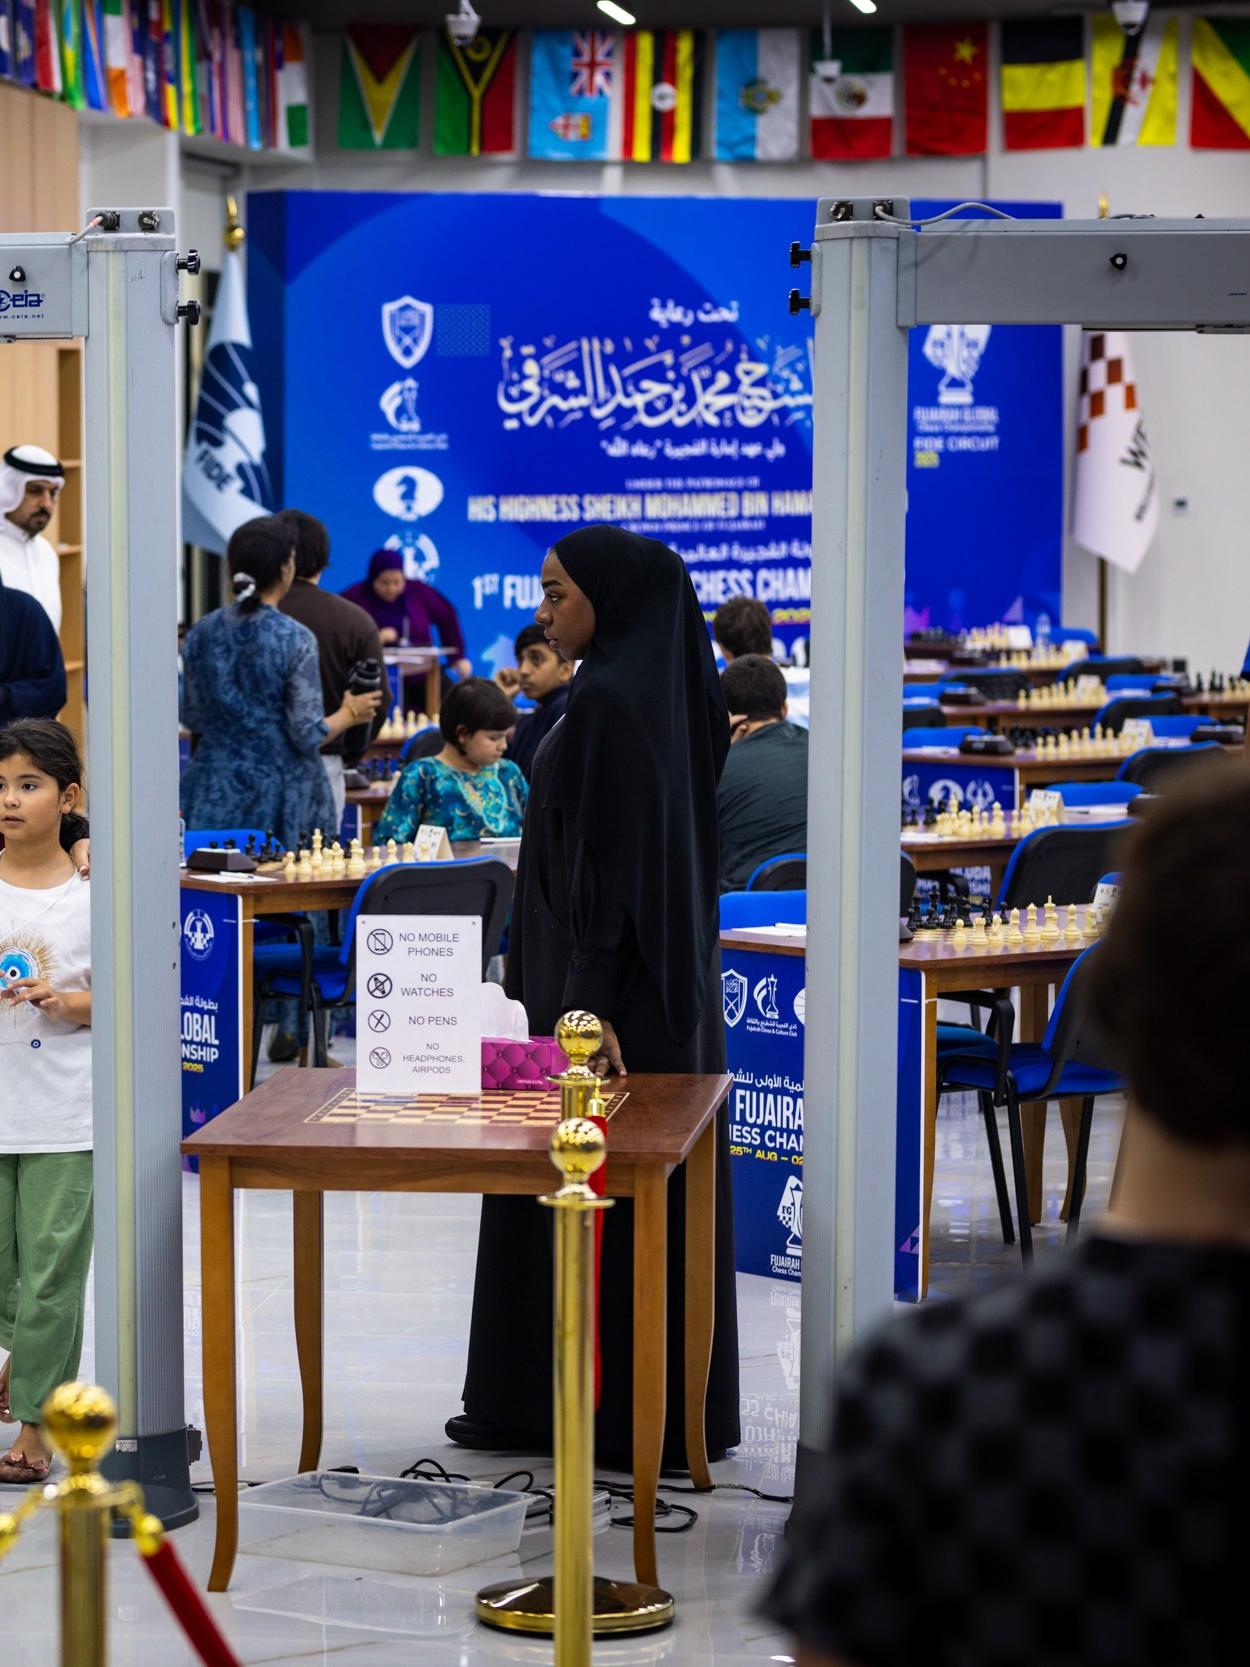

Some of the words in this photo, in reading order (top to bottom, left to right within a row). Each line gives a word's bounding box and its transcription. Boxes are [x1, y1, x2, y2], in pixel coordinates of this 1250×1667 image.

[650, 298, 695, 328] رعاية
[697, 300, 739, 322] تحت
[468, 495, 497, 522] HIS
[499, 494, 580, 521] HIGHNESS
[582, 492, 642, 520] SHEIKH
[644, 491, 740, 518] MOHAMMED
[742, 490, 769, 517] BIN
[691, 569, 754, 604] CHESS
[399, 933, 415, 943] NO
[418, 933, 459, 943] MOBILE
[407, 947, 454, 957] PHONES
[421, 973, 437, 983] NO
[400, 987, 454, 997] WATCHES
[195, 995, 219, 1013] بطولة
[408, 1016, 425, 1026] NO
[428, 1016, 457, 1026] PENS
[181, 1011, 219, 1045] OBAL
[746, 1025, 761, 1033] Fujairah
[761, 1026, 771, 1034] Chess
[776, 1028, 788, 1036] Culture
[426, 1042, 439, 1051] NO
[402, 1055, 465, 1064] HEADPHONES,
[182, 1061, 204, 1073] 2025
[412, 1066, 451, 1074] AIRPODS
[755, 1073, 782, 1090] الأولى
[735, 1088, 804, 1131] FUJAIRA
[729, 1124, 760, 1145] ESS
[730, 1145, 752, 1156] 25TH
[755, 1149, 778, 1162] AUG
[782, 1205, 792, 1215] FG
[770, 1254, 800, 1270] FUJAIRAH
[772, 1266, 787, 1275] Chess
